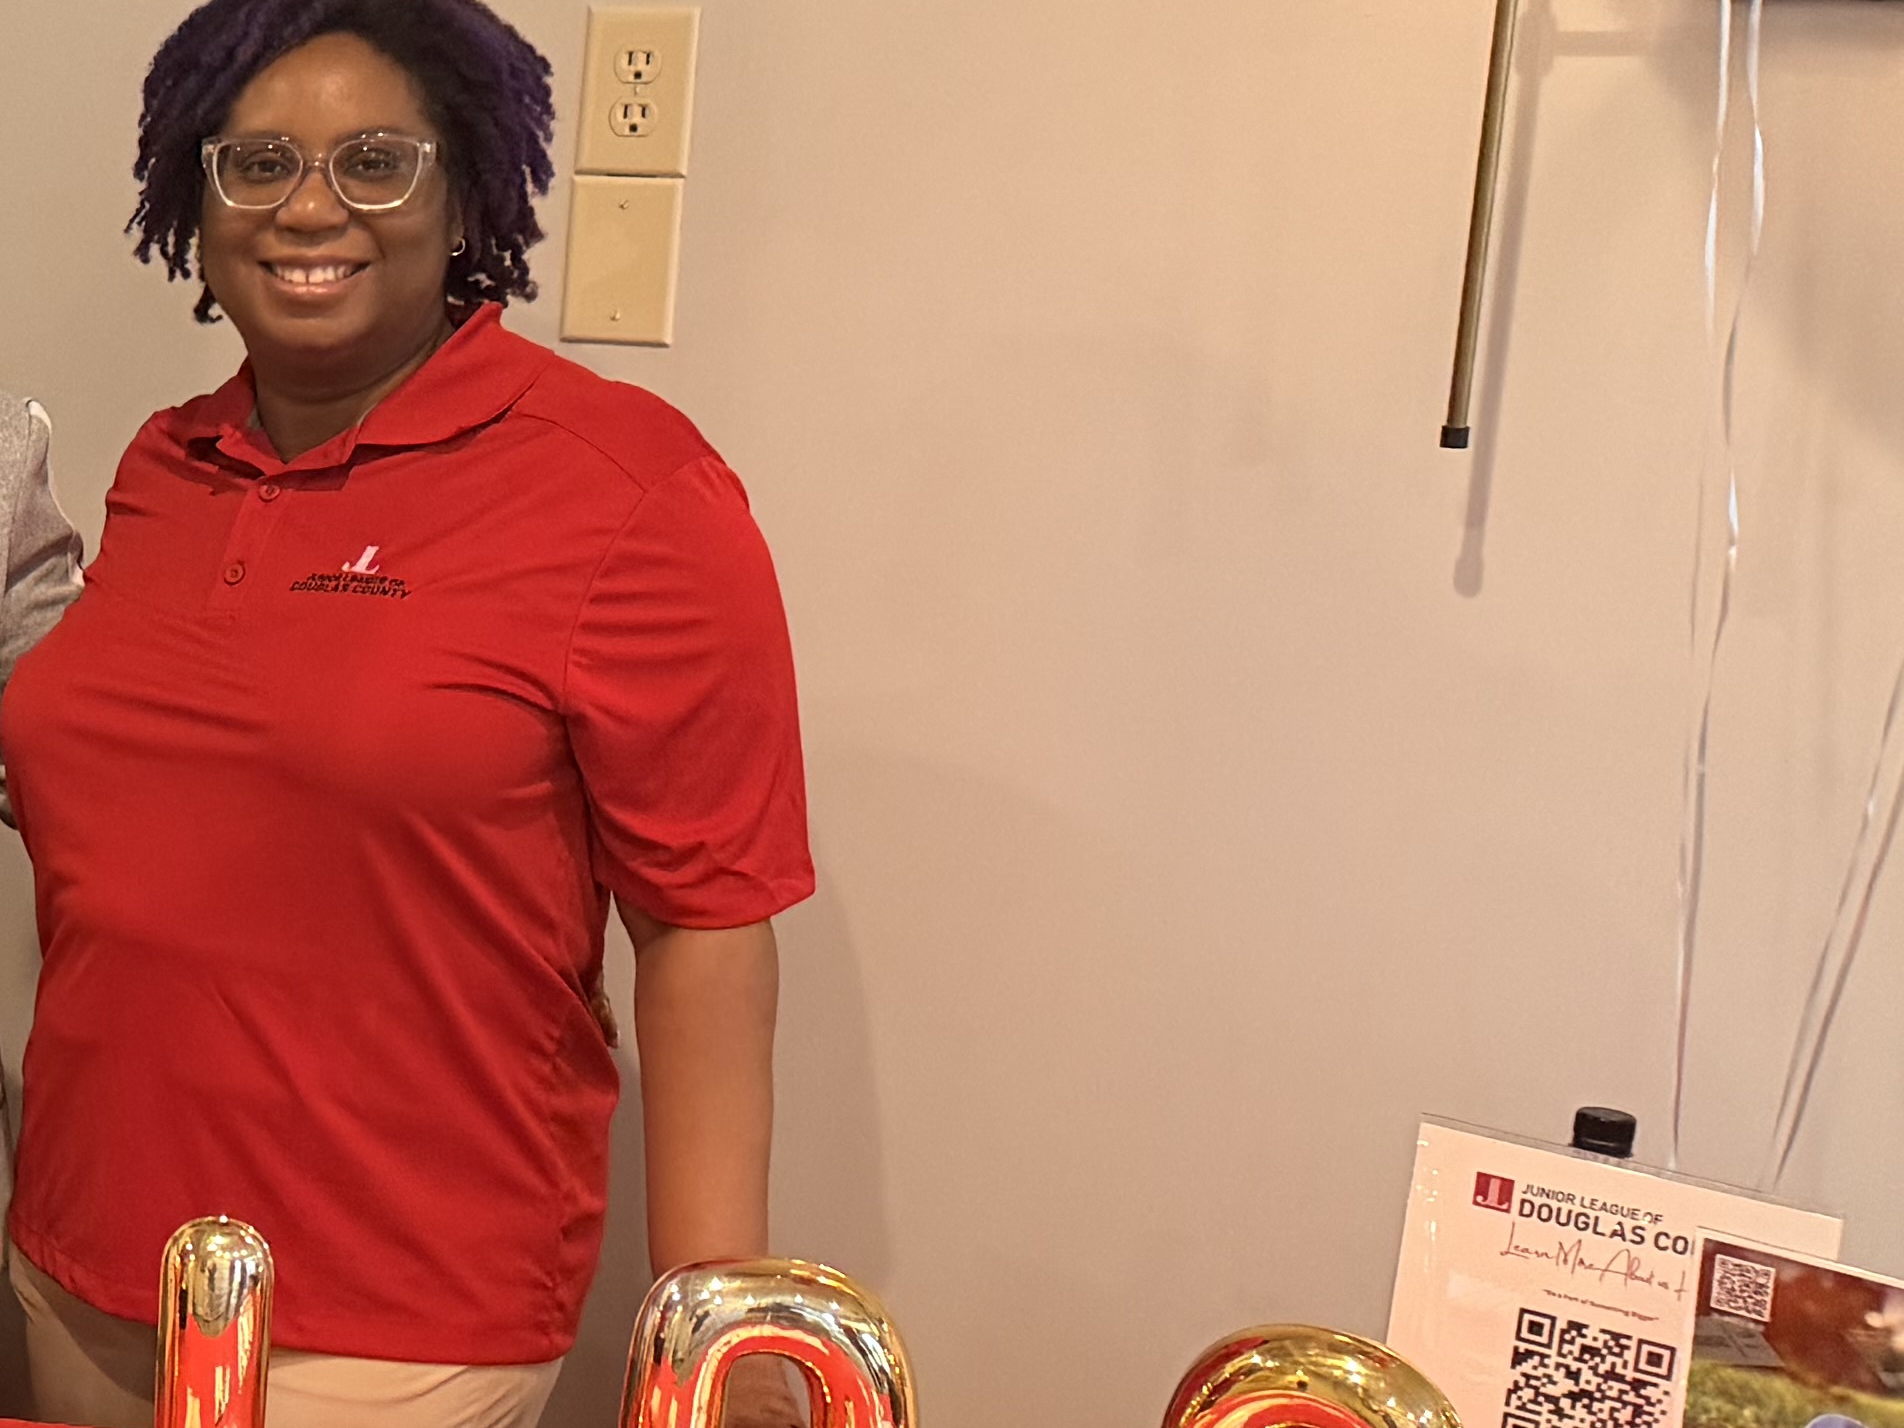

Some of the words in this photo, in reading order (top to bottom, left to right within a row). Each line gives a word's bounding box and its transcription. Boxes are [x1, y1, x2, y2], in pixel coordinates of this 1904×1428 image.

[351, 583, 412, 600] COUNTY
[1521, 1183, 1577, 1205] JUNIOR
[1579, 1196, 1641, 1221] LEAGUE
[1643, 1211, 1664, 1226] OF
[1499, 1220, 1553, 1260] Learn
[1518, 1197, 1648, 1246] DOUGLAS
[1652, 1231, 1695, 1257] CO
